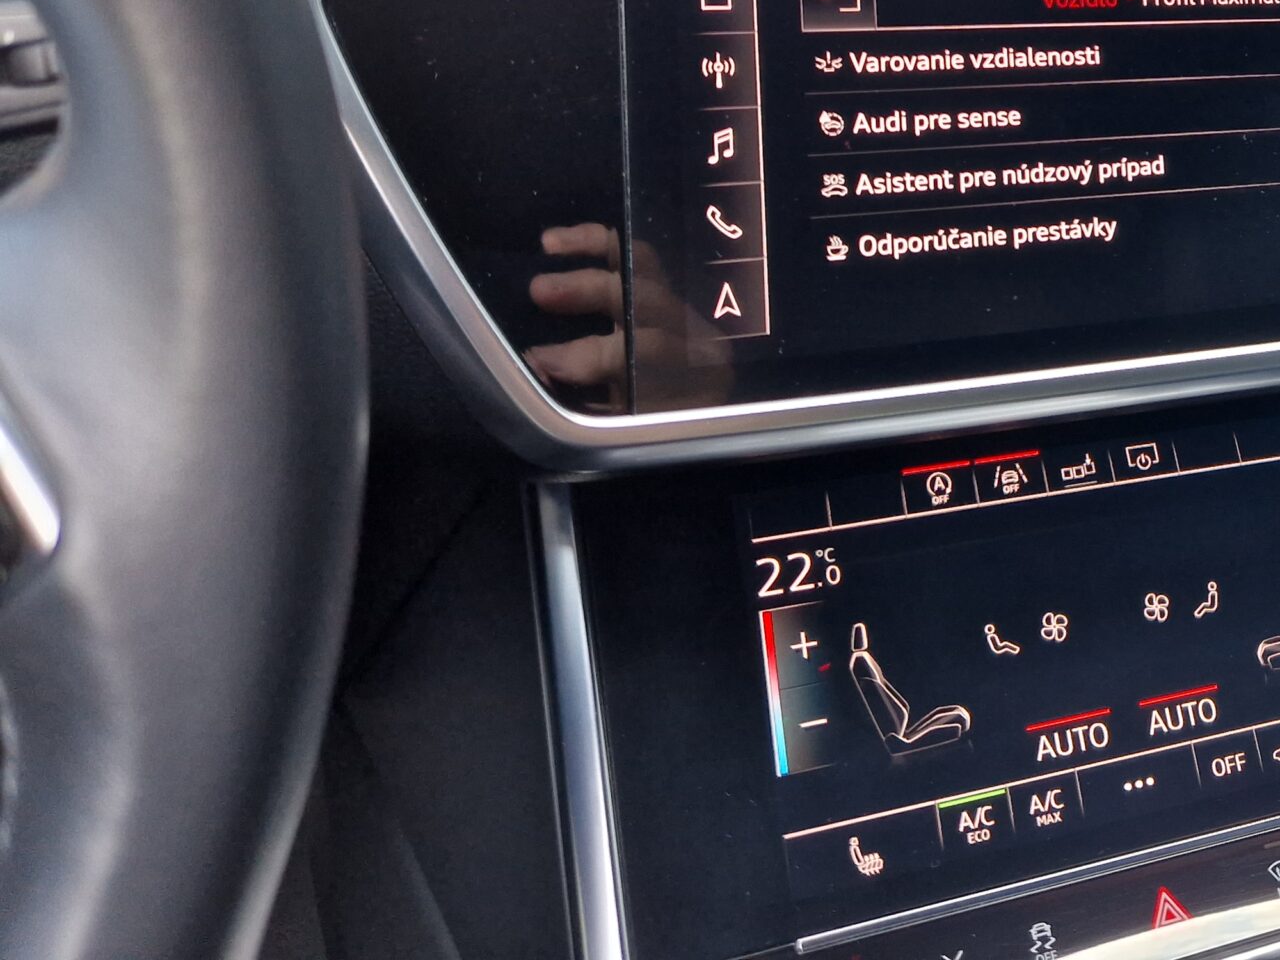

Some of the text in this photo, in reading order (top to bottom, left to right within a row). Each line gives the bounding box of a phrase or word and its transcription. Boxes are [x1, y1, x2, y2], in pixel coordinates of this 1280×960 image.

[850, 45, 1101, 74] Varovanie vzdialenosti
[853, 109, 1022, 136] Audi pre sense
[856, 155, 1165, 195] Asistent pre núdzový prípad
[859, 216, 1117, 259] Odporúčanie prestávky
[931, 494, 950, 506] OFF
[1002, 484, 1020, 495] OFF
[1149, 699, 1217, 736] AUTO
[1036, 723, 1109, 762] AUTO
[1211, 752, 1247, 778] OFF
[1029, 790, 1065, 816] A/C
[958, 805, 995, 833] A/C
[1035, 811, 1063, 827] MAX
[967, 829, 991, 844] ECO
